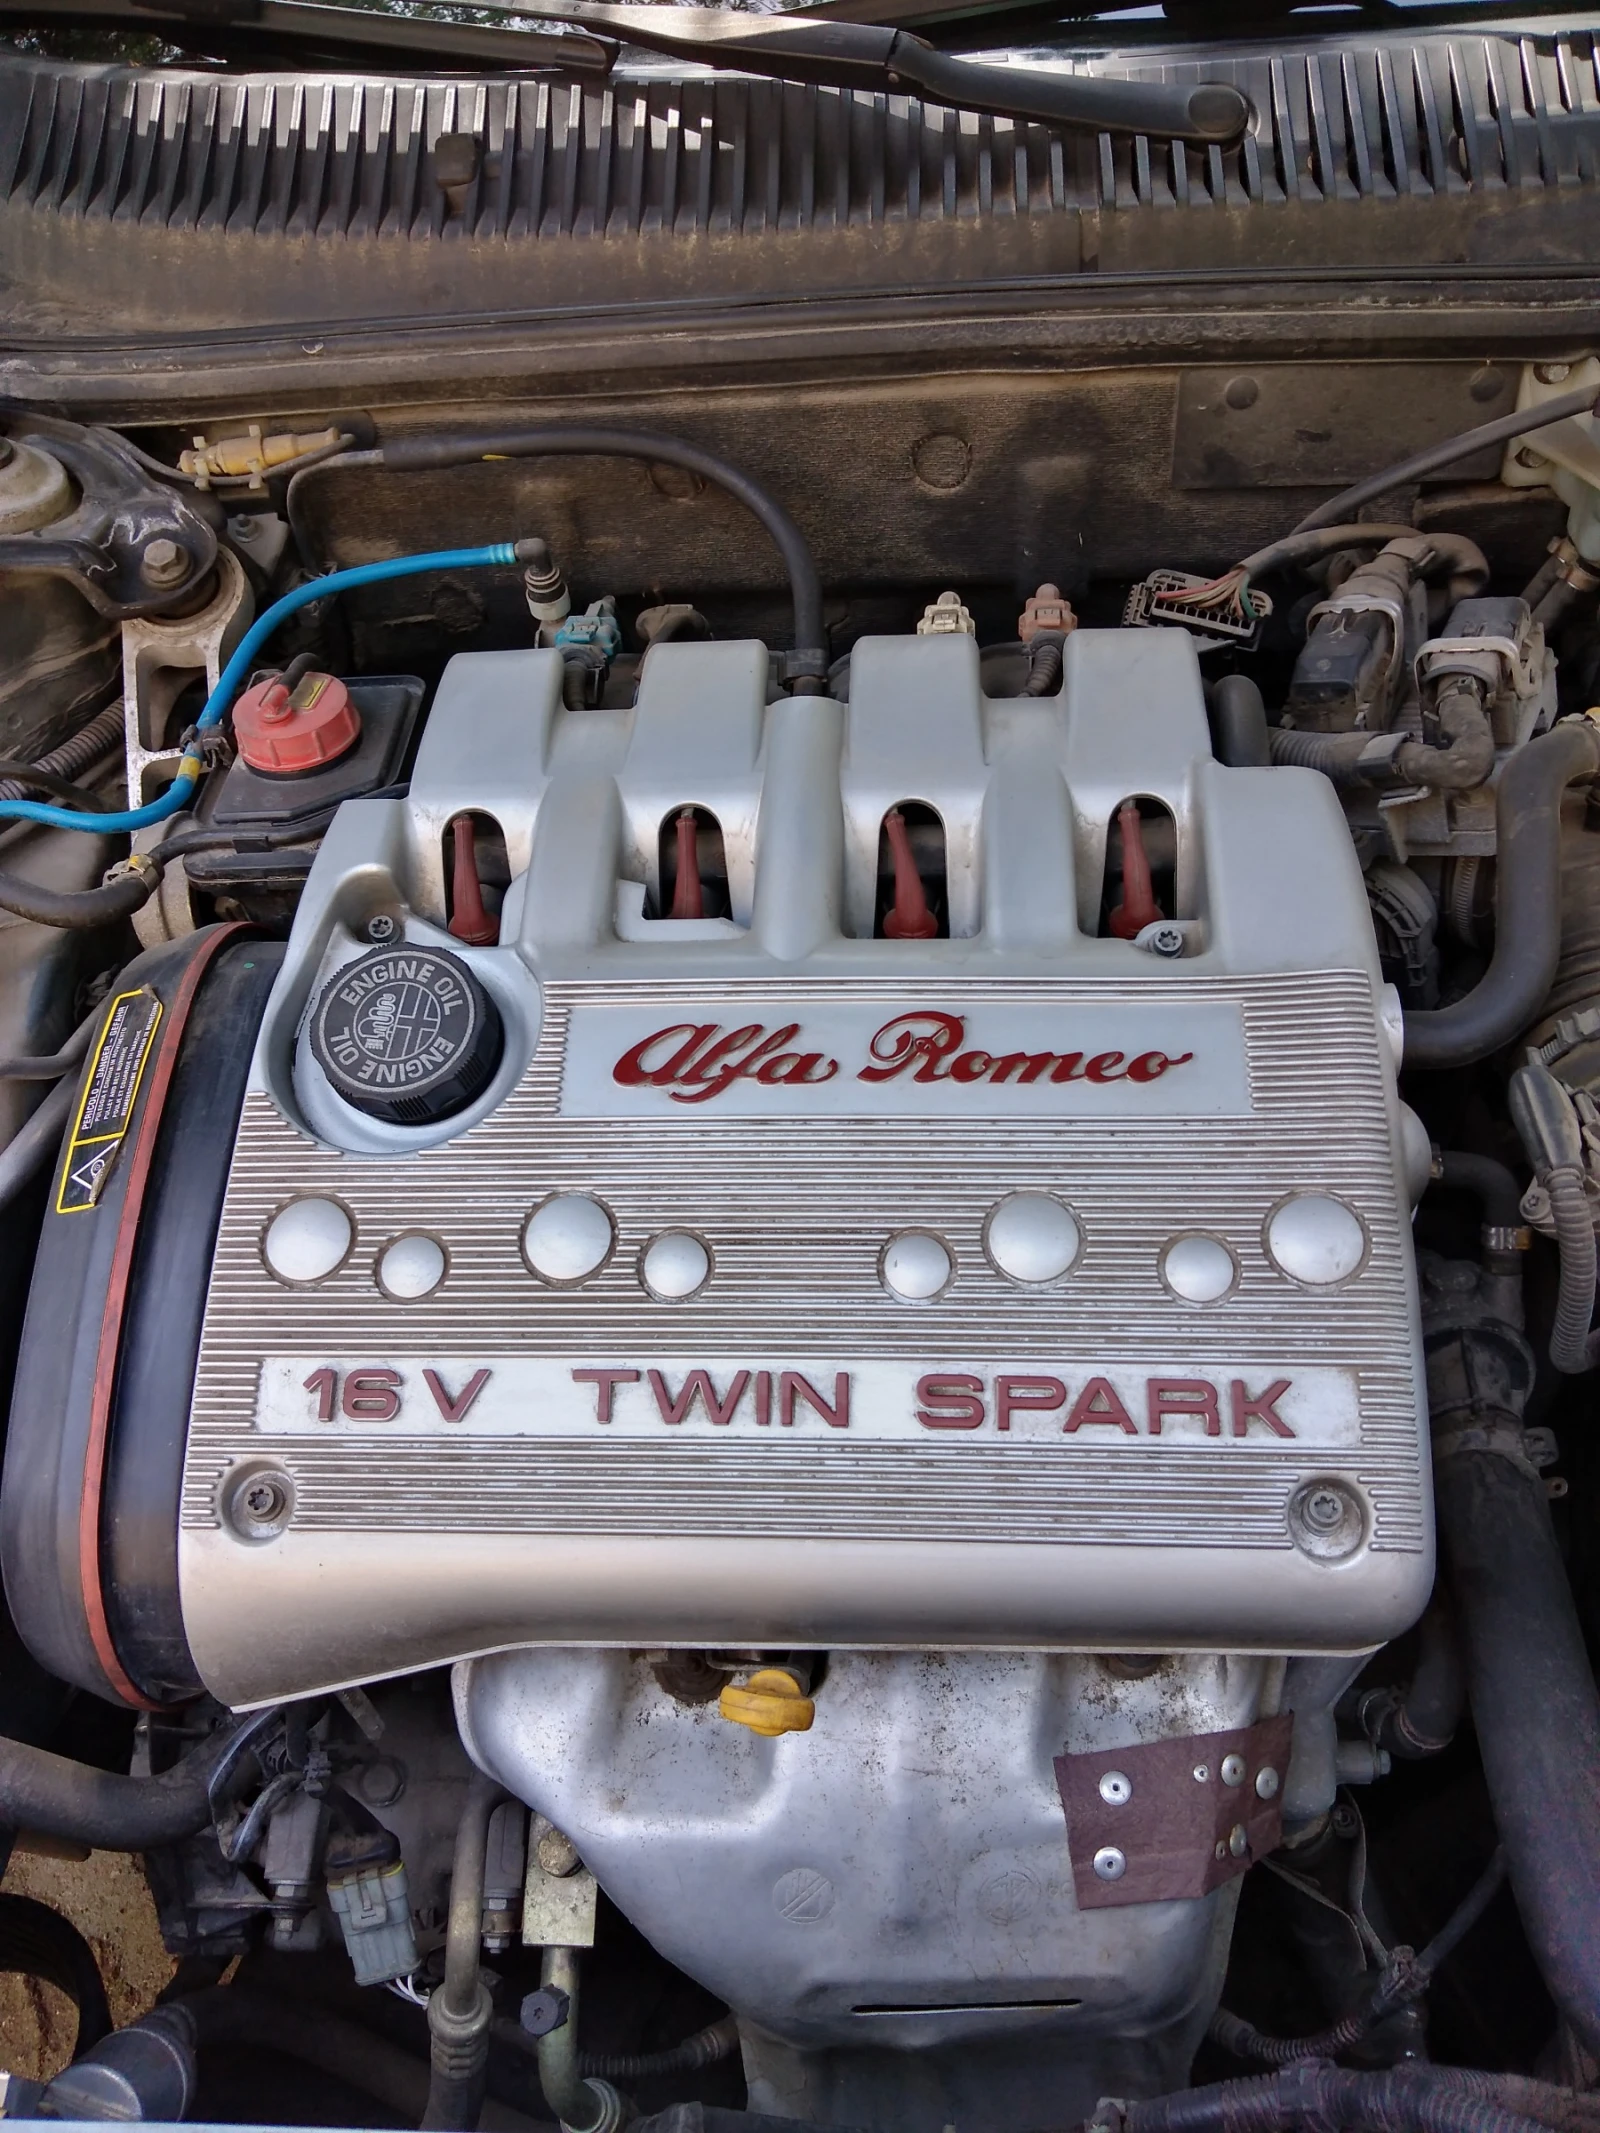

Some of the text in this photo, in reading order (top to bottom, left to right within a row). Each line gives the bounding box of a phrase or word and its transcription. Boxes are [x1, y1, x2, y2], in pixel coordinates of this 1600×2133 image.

[340, 960, 463, 1016] ENGINE OIL
[81, 1088, 100, 1130] PERICOLO
[96, 1045, 111, 1078] DANGER
[109, 1006, 126, 1036] GEFAHR
[330, 1027, 455, 1083] ENGINE OIL
[613, 1010, 1193, 1104] Alfa Romeo
[104, 1099, 114, 1120] PULLEY
[572, 1369, 850, 1428] TWIN
[916, 1374, 1297, 1438] SPARK
